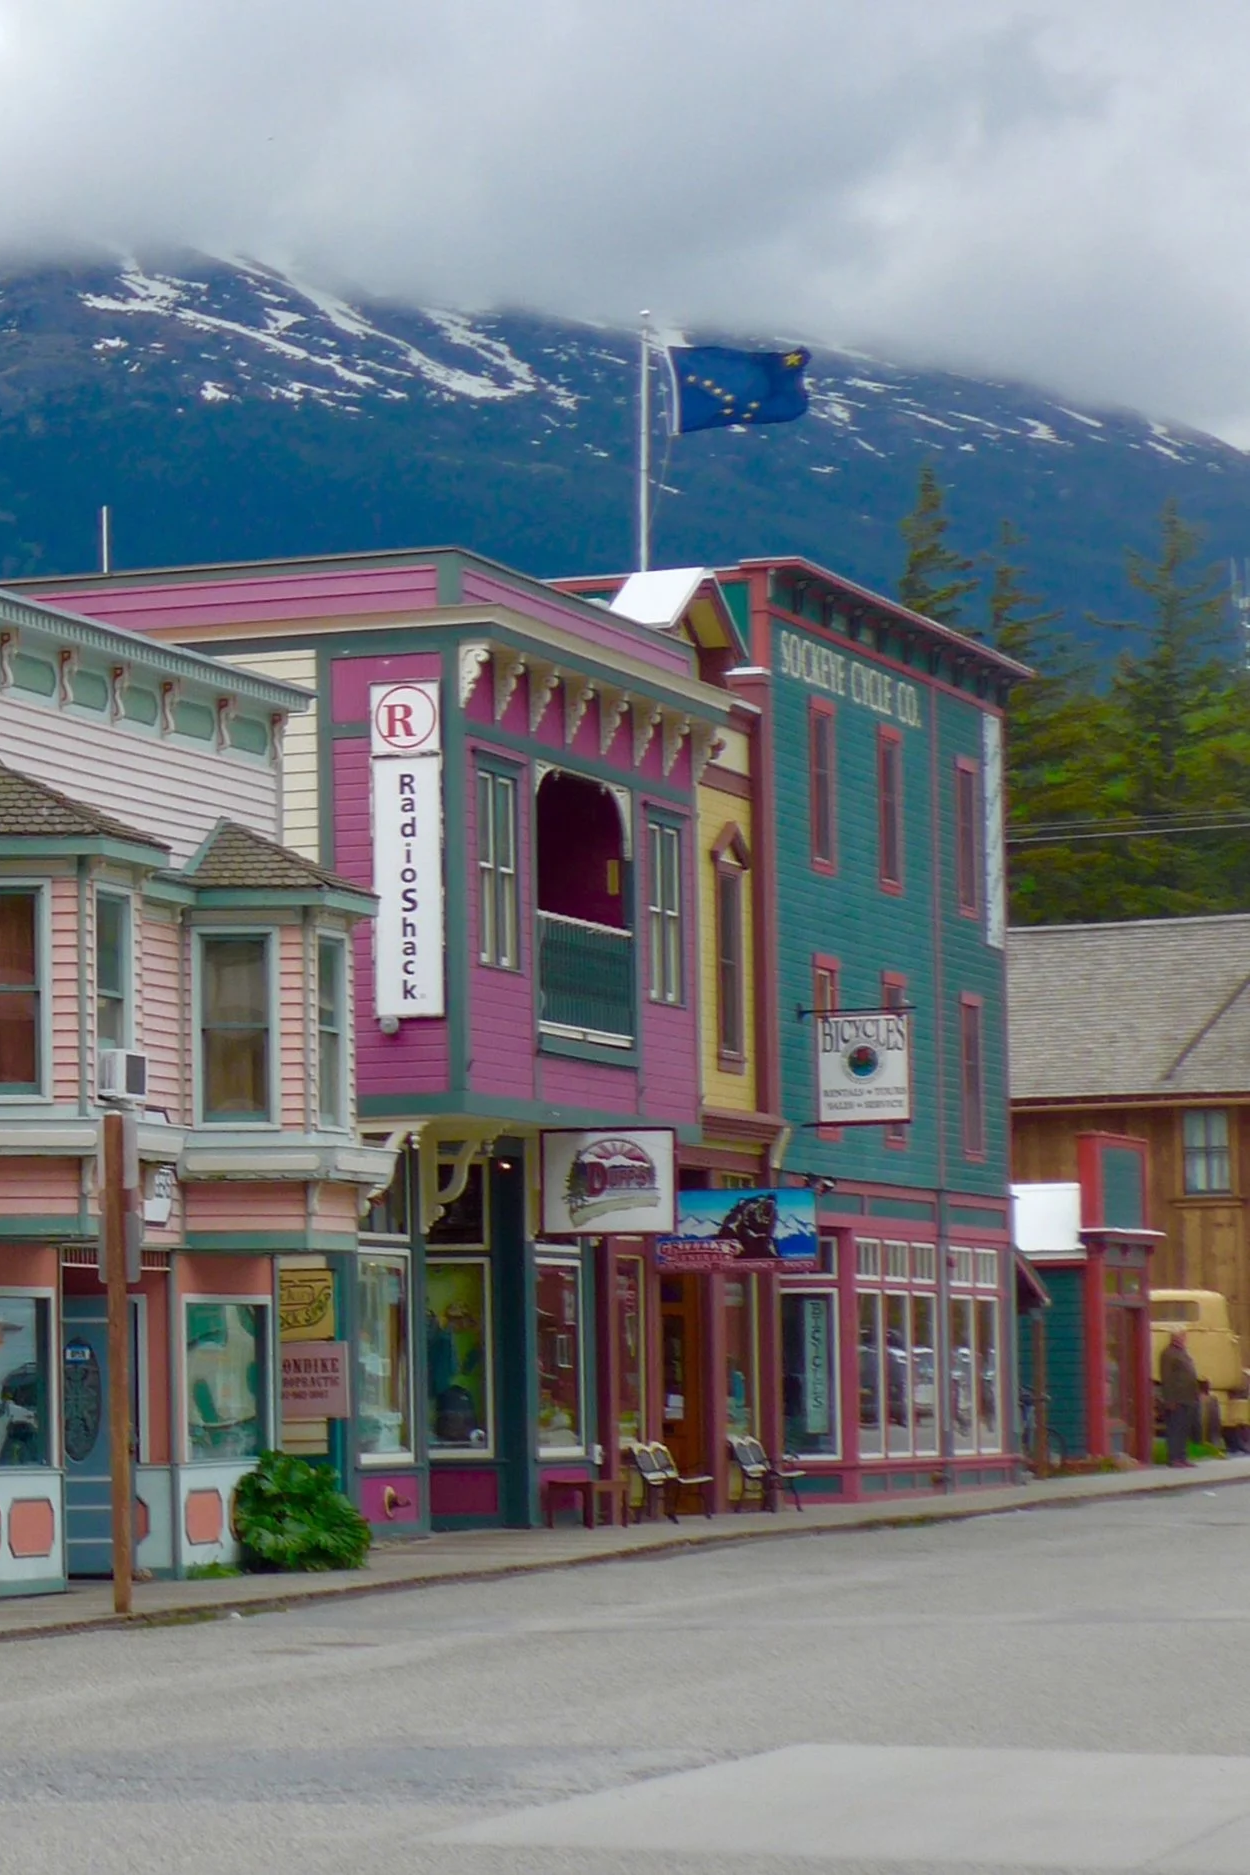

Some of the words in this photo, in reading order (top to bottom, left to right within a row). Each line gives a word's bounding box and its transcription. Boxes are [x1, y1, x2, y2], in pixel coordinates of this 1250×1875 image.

[781, 630, 846, 697] SOCKEYE
[851, 661, 893, 716] CYCLE
[382, 703, 417, 738] R
[398, 773, 420, 1000] RadioShack
[821, 1018, 905, 1053] BICYCLES
